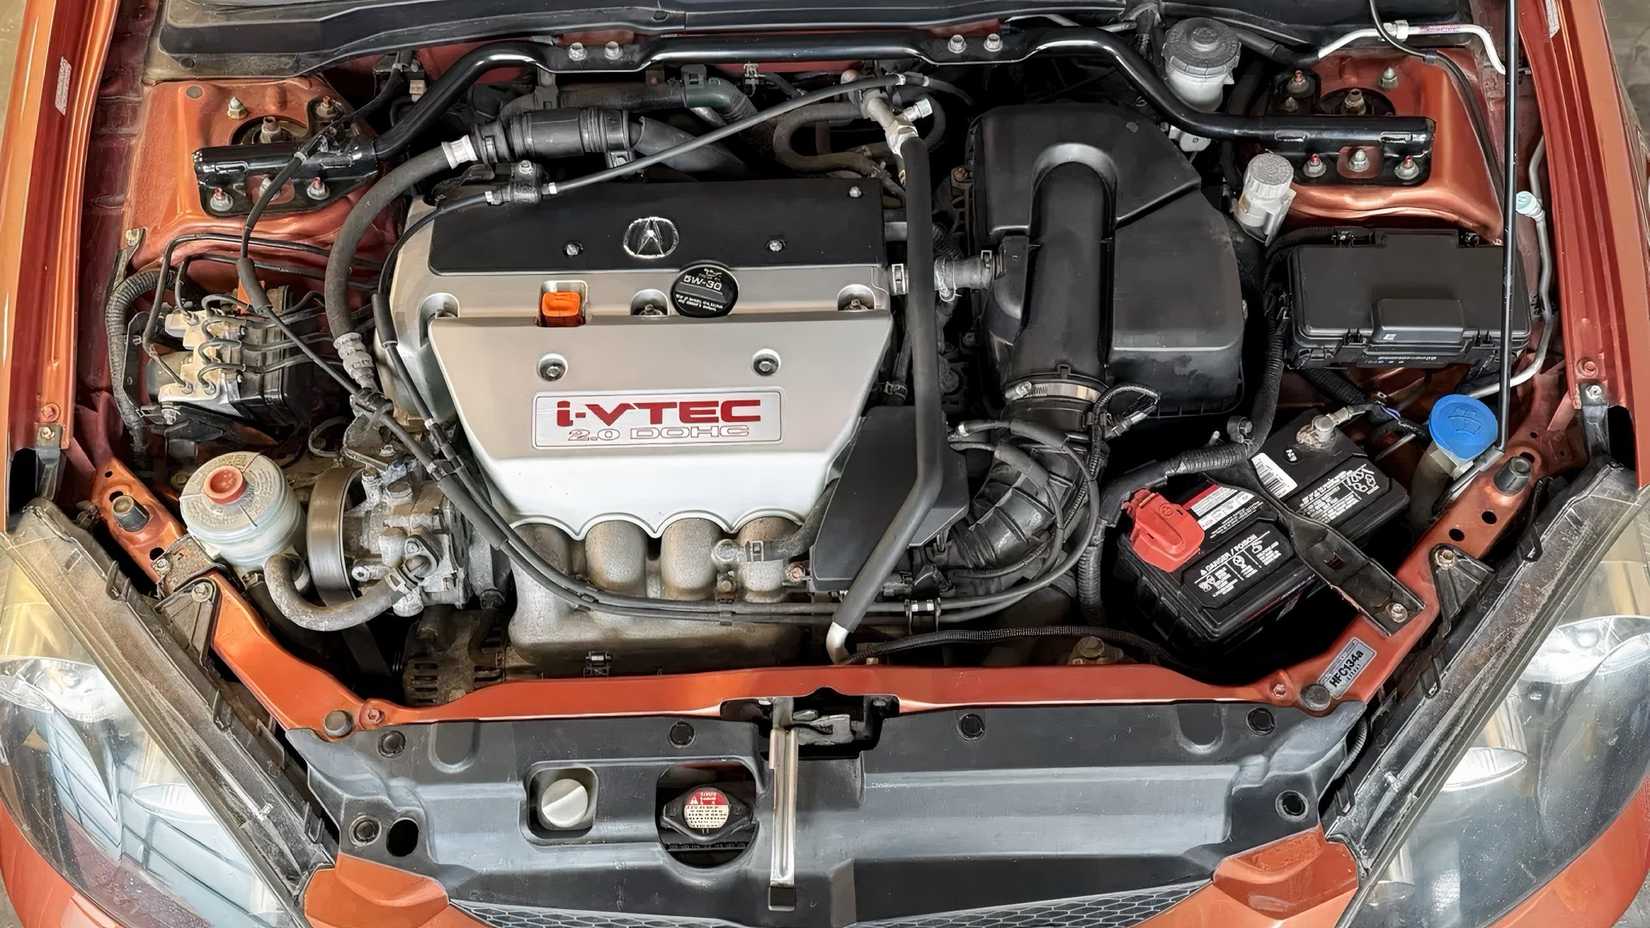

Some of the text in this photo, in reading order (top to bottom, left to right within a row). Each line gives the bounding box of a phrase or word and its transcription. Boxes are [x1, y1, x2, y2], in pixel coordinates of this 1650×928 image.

[683, 274, 722, 291] 5W-30
[556, 399, 761, 427] i-VTEC
[568, 425, 750, 442] 2.0 DOHC
[1204, 551, 1231, 572] DANGER
[1233, 533, 1258, 552] POISON
[1329, 650, 1364, 688] HFC134a
